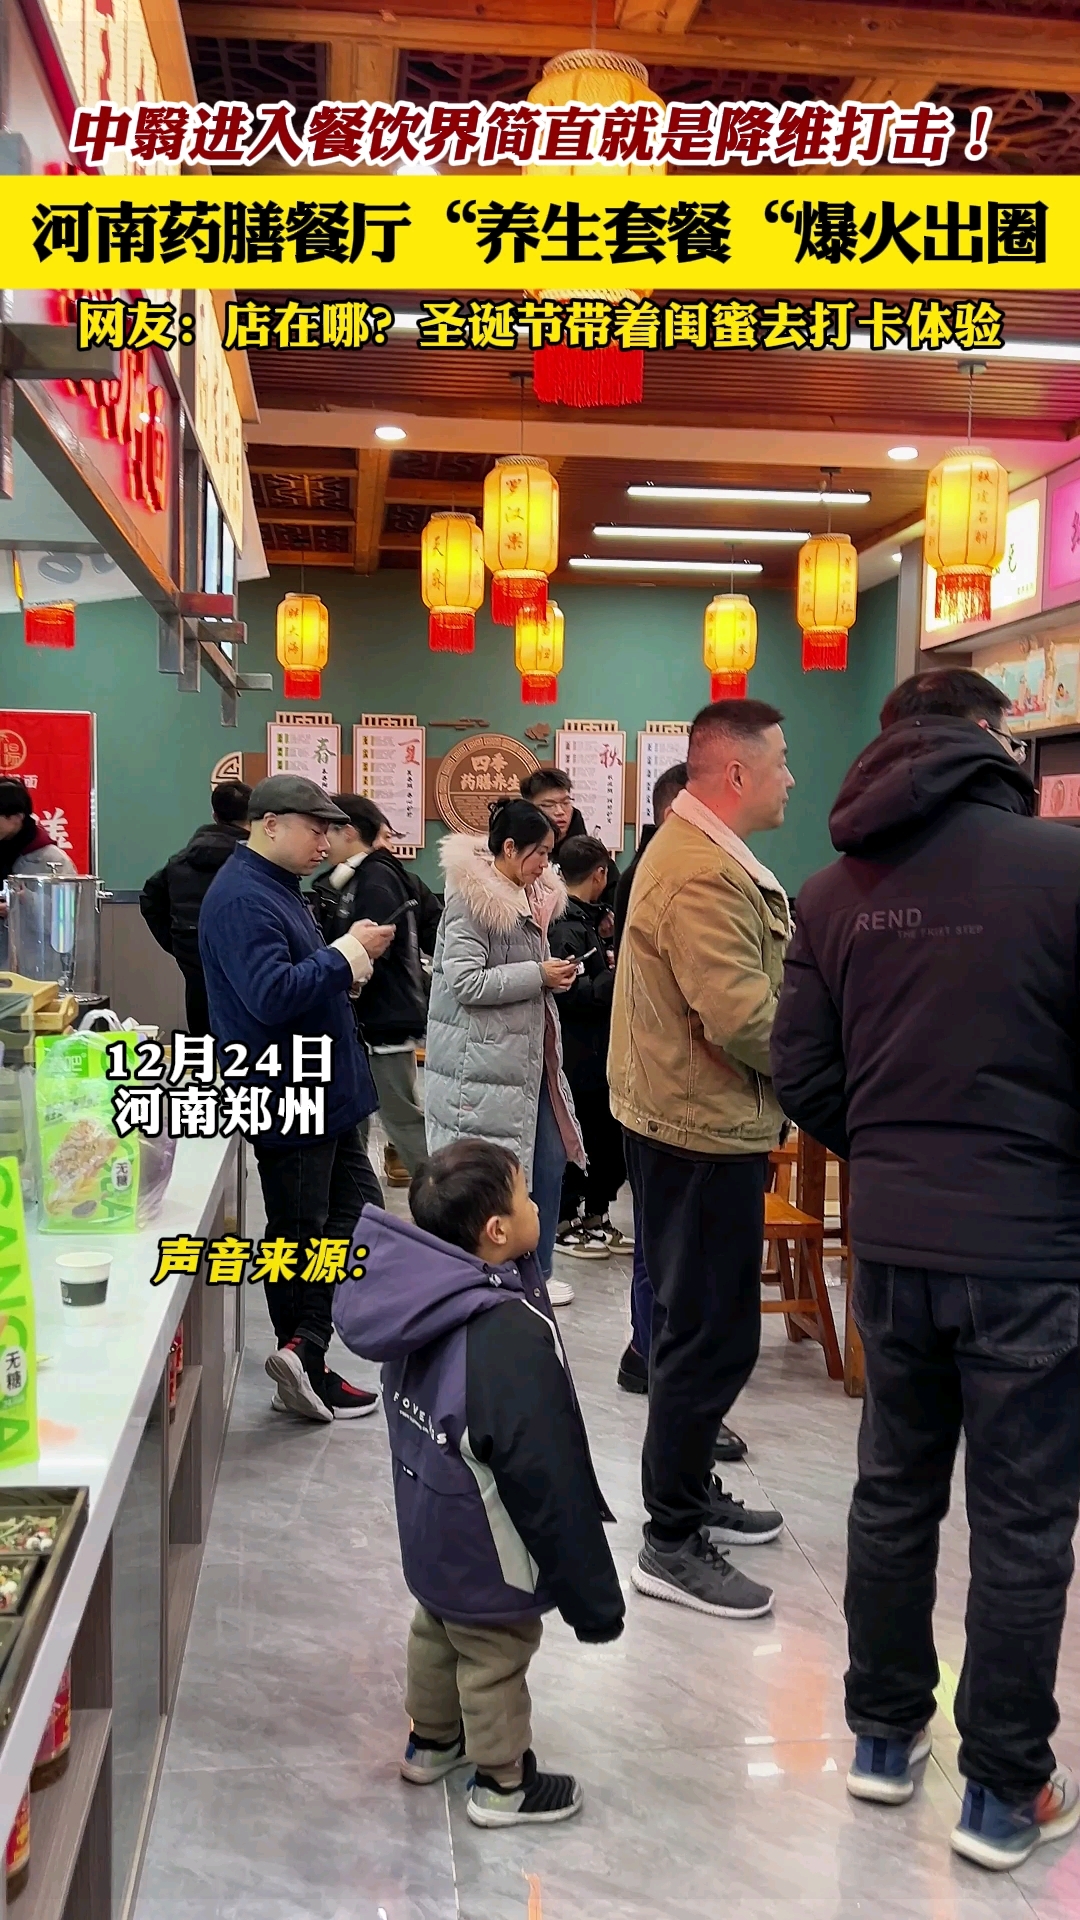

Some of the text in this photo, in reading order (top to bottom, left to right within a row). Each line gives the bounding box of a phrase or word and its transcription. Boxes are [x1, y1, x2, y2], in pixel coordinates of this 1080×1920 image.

[313, 737, 336, 764] 春
[398, 738, 420, 766] 夏
[470, 752, 509, 773] 四季
[599, 743, 623, 769] 秋
[459, 772, 521, 792] 药膳养生
[854, 908, 922, 931] REND
[5, 1351, 22, 1391] 无糖
